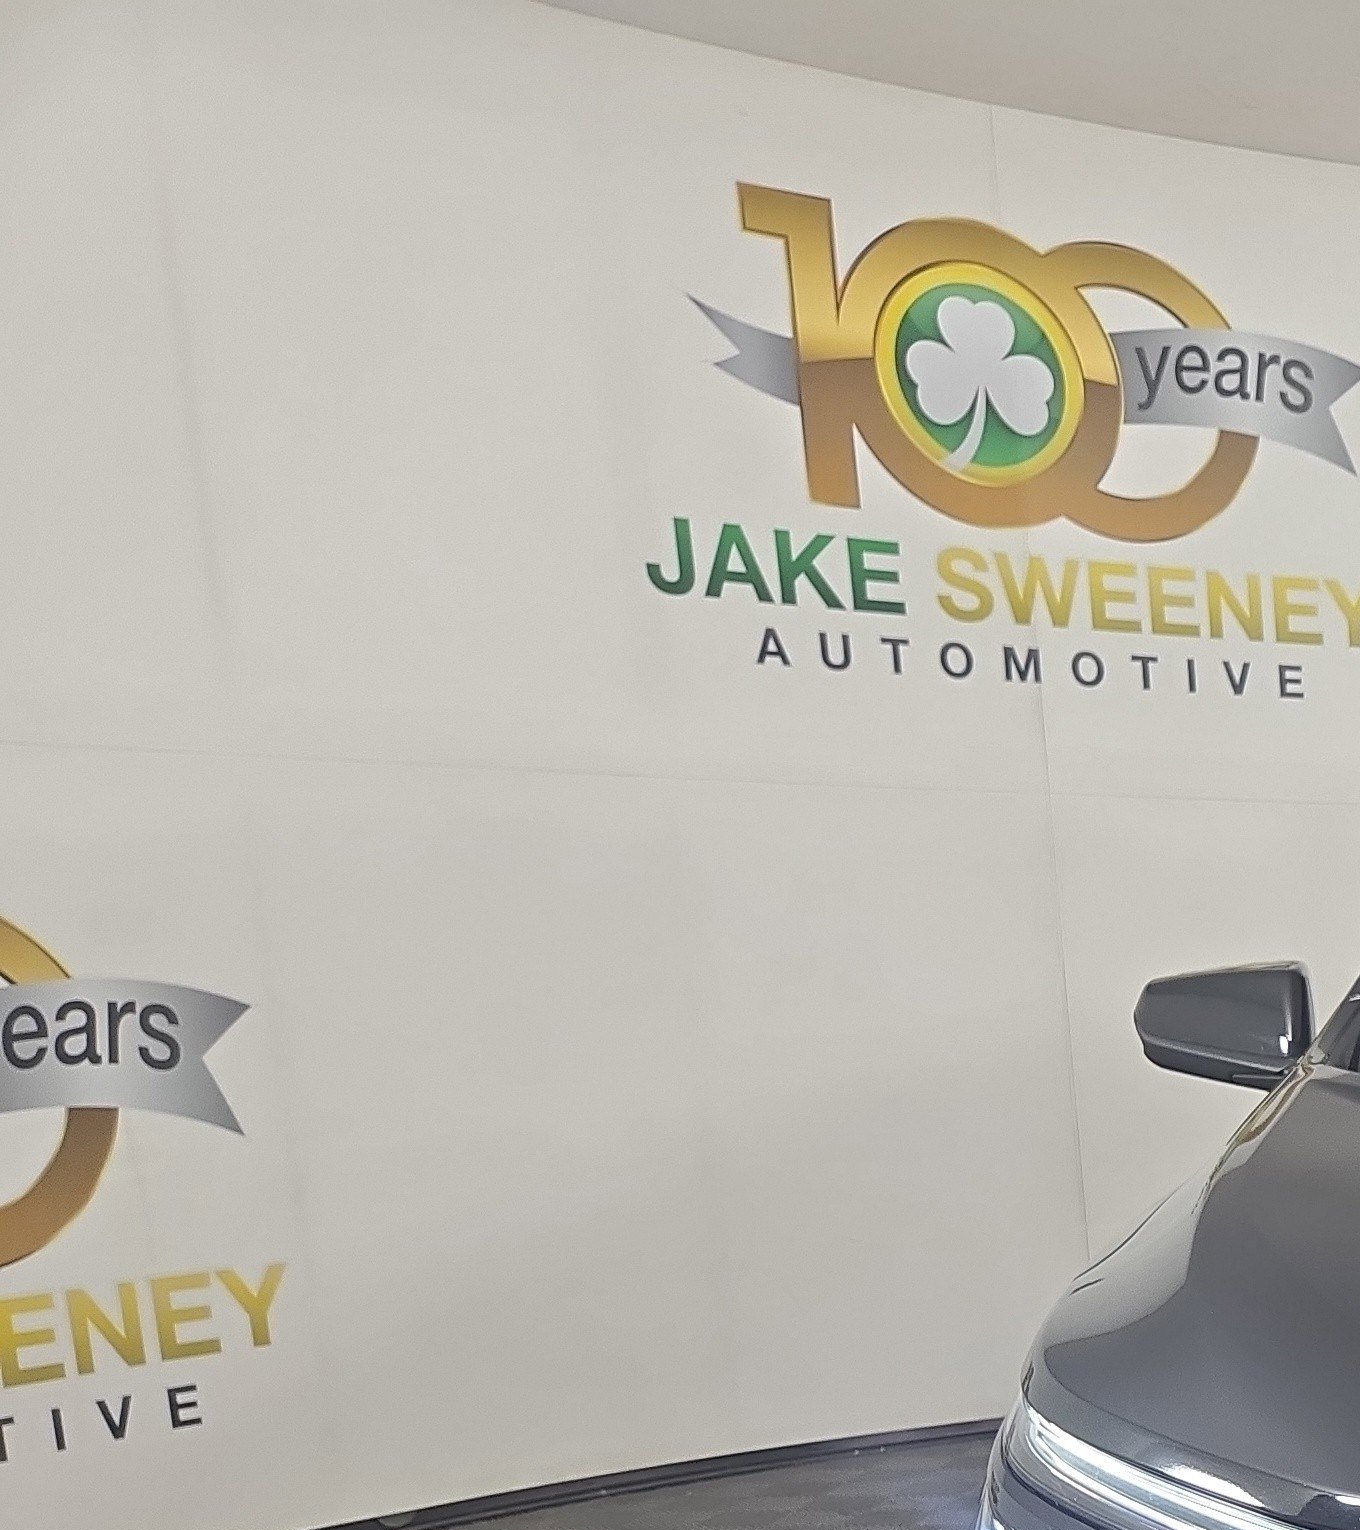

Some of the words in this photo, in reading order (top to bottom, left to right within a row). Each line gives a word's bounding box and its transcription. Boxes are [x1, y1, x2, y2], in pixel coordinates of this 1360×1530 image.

[1134, 336, 1316, 415] years
[645, 516, 908, 616] JAKE
[756, 627, 1305, 700] AUTOMOTIVE
